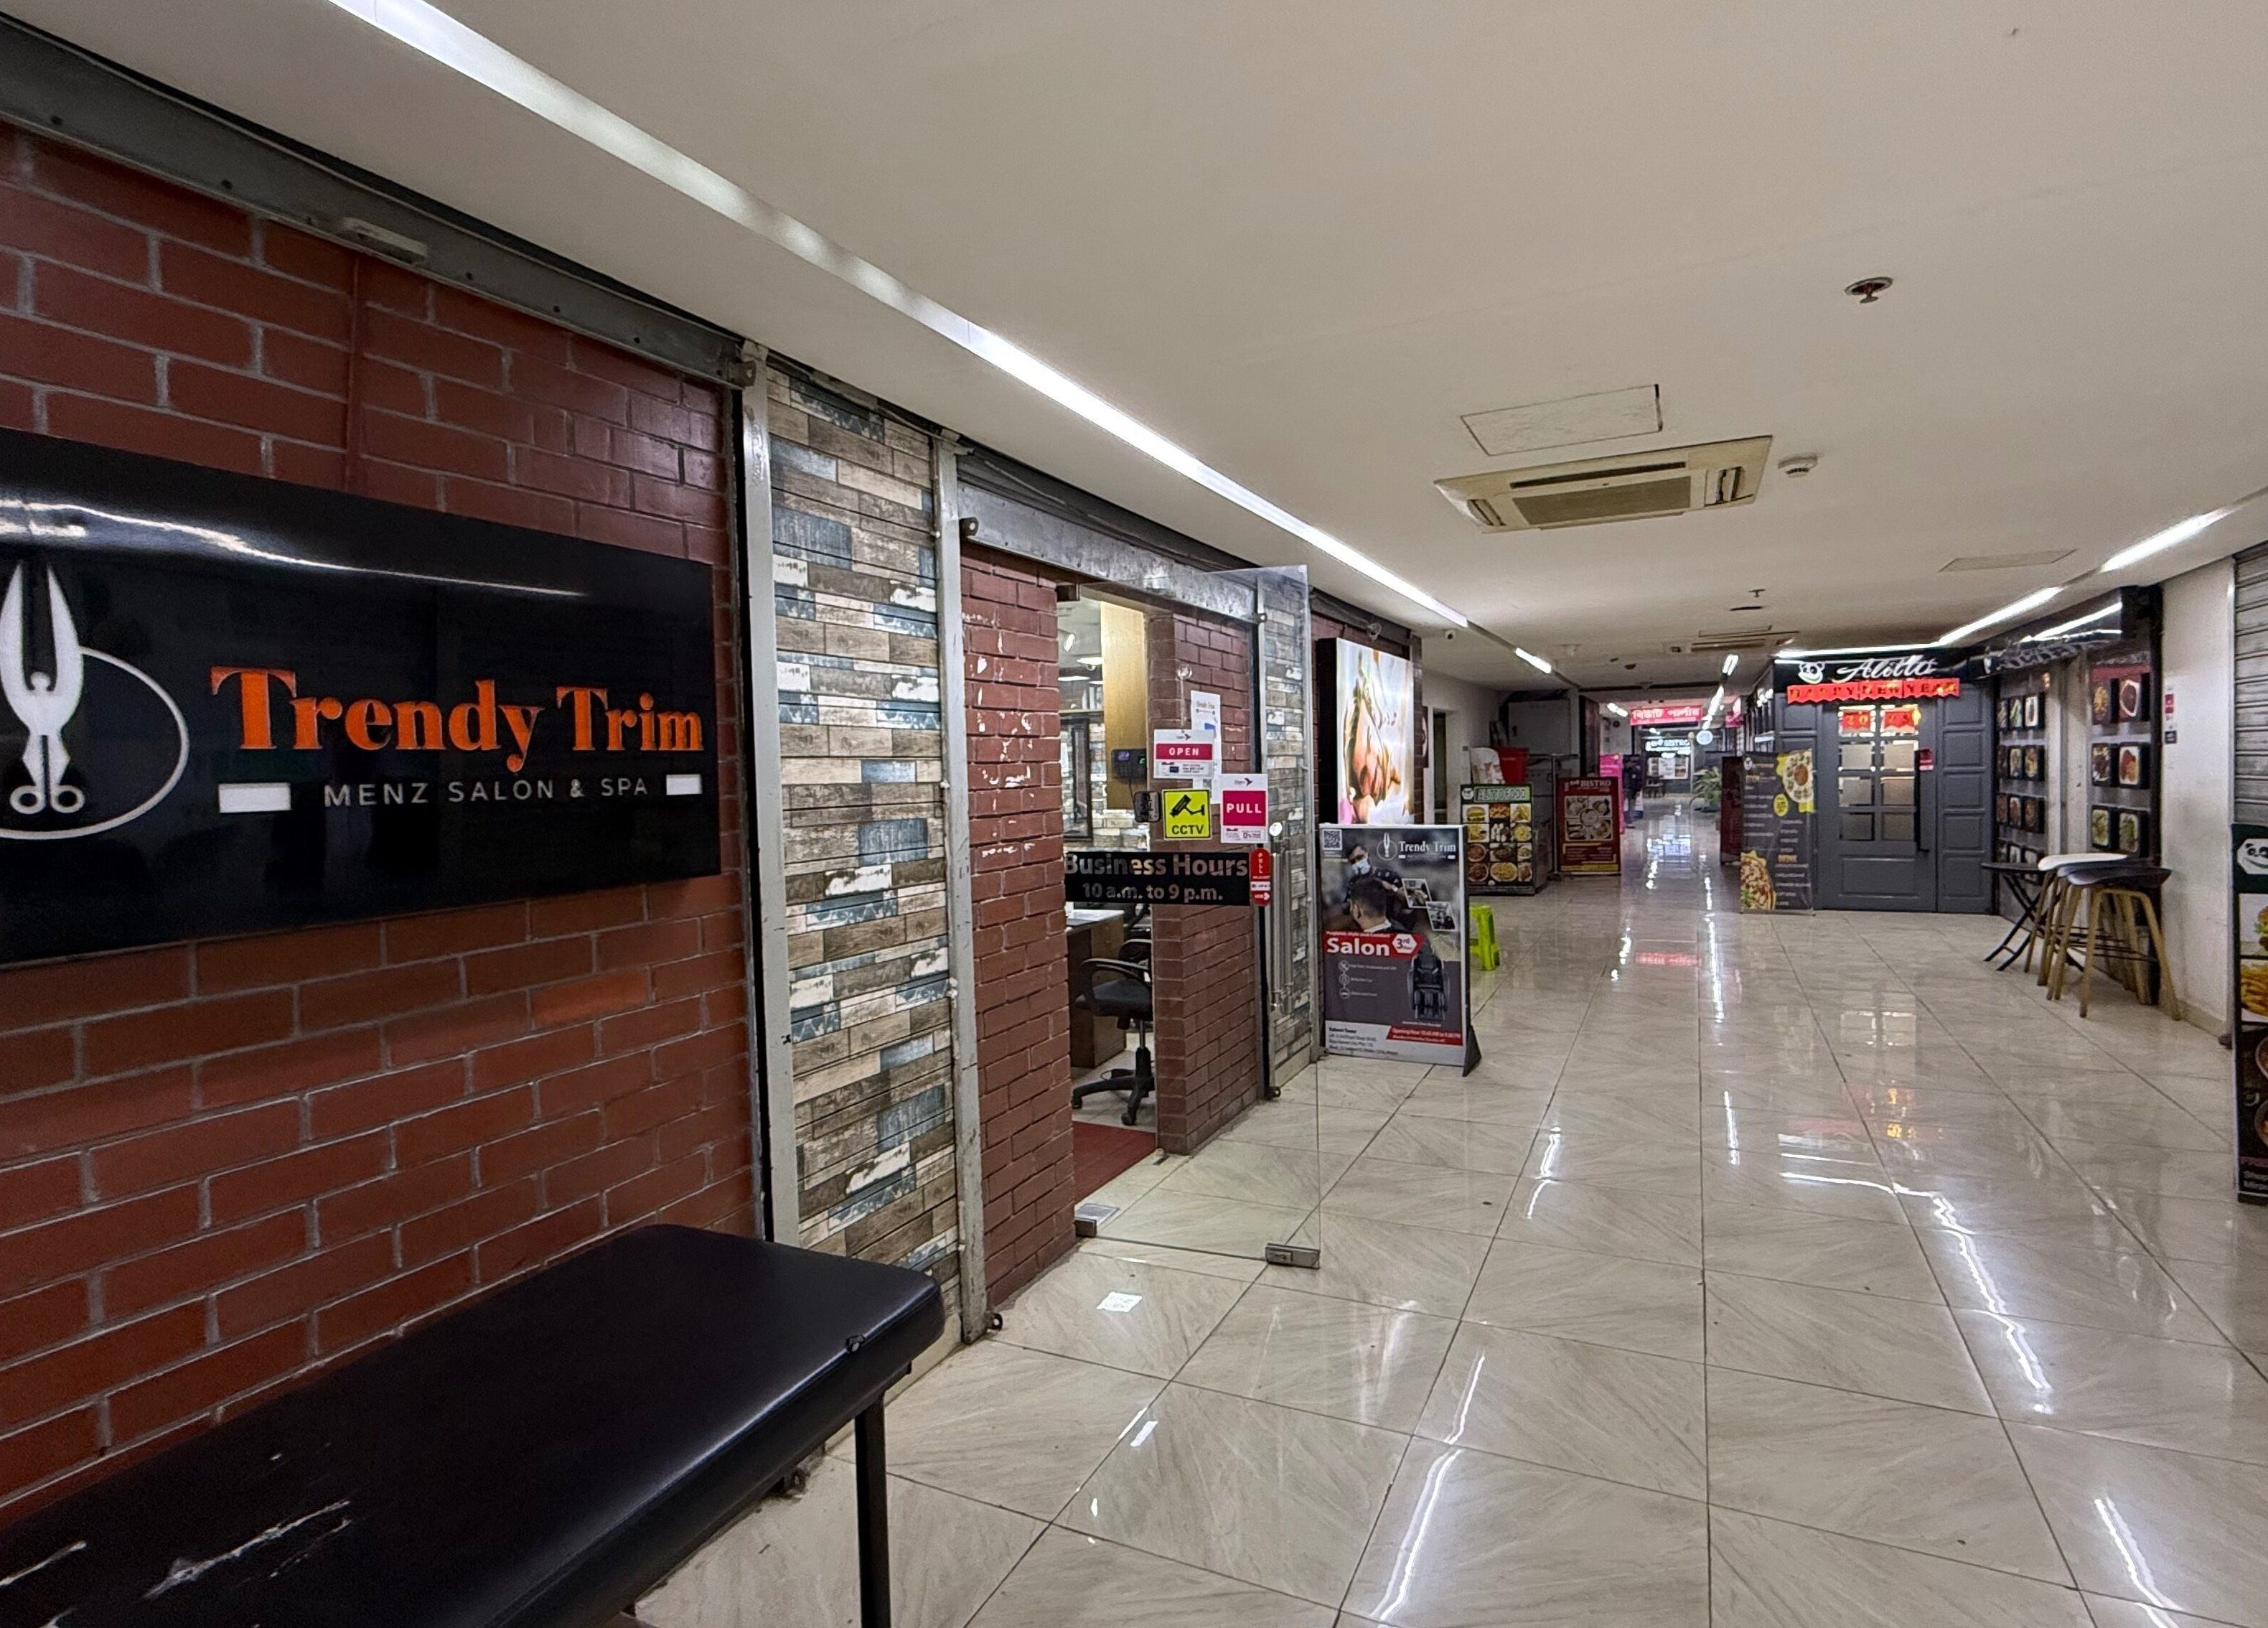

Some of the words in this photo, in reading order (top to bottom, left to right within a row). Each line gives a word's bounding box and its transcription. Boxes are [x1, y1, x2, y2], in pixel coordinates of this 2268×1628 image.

[1789, 686, 1856, 698] HAPPY
[1862, 684, 1900, 695] NEW
[210, 665, 544, 772] Trendy
[556, 686, 703, 752] Trim
[1168, 747, 1199, 756] OPEN
[324, 782, 429, 807] MENZ
[448, 779, 553, 803] SALON
[569, 778, 584, 798] &
[601, 777, 648, 797] SPA
[1226, 803, 1262, 814] PULL
[1171, 825, 1204, 835] CCTV
[1064, 853, 1166, 875] Business
[1173, 854, 1248, 876] Hours
[1082, 883, 1103, 898] 10
[1105, 885, 1143, 899] a.m.
[1146, 884, 1165, 899] to
[1168, 884, 1180, 899] 9
[1184, 886, 1224, 903] p.m.
[1326, 937, 1390, 956] Salon
